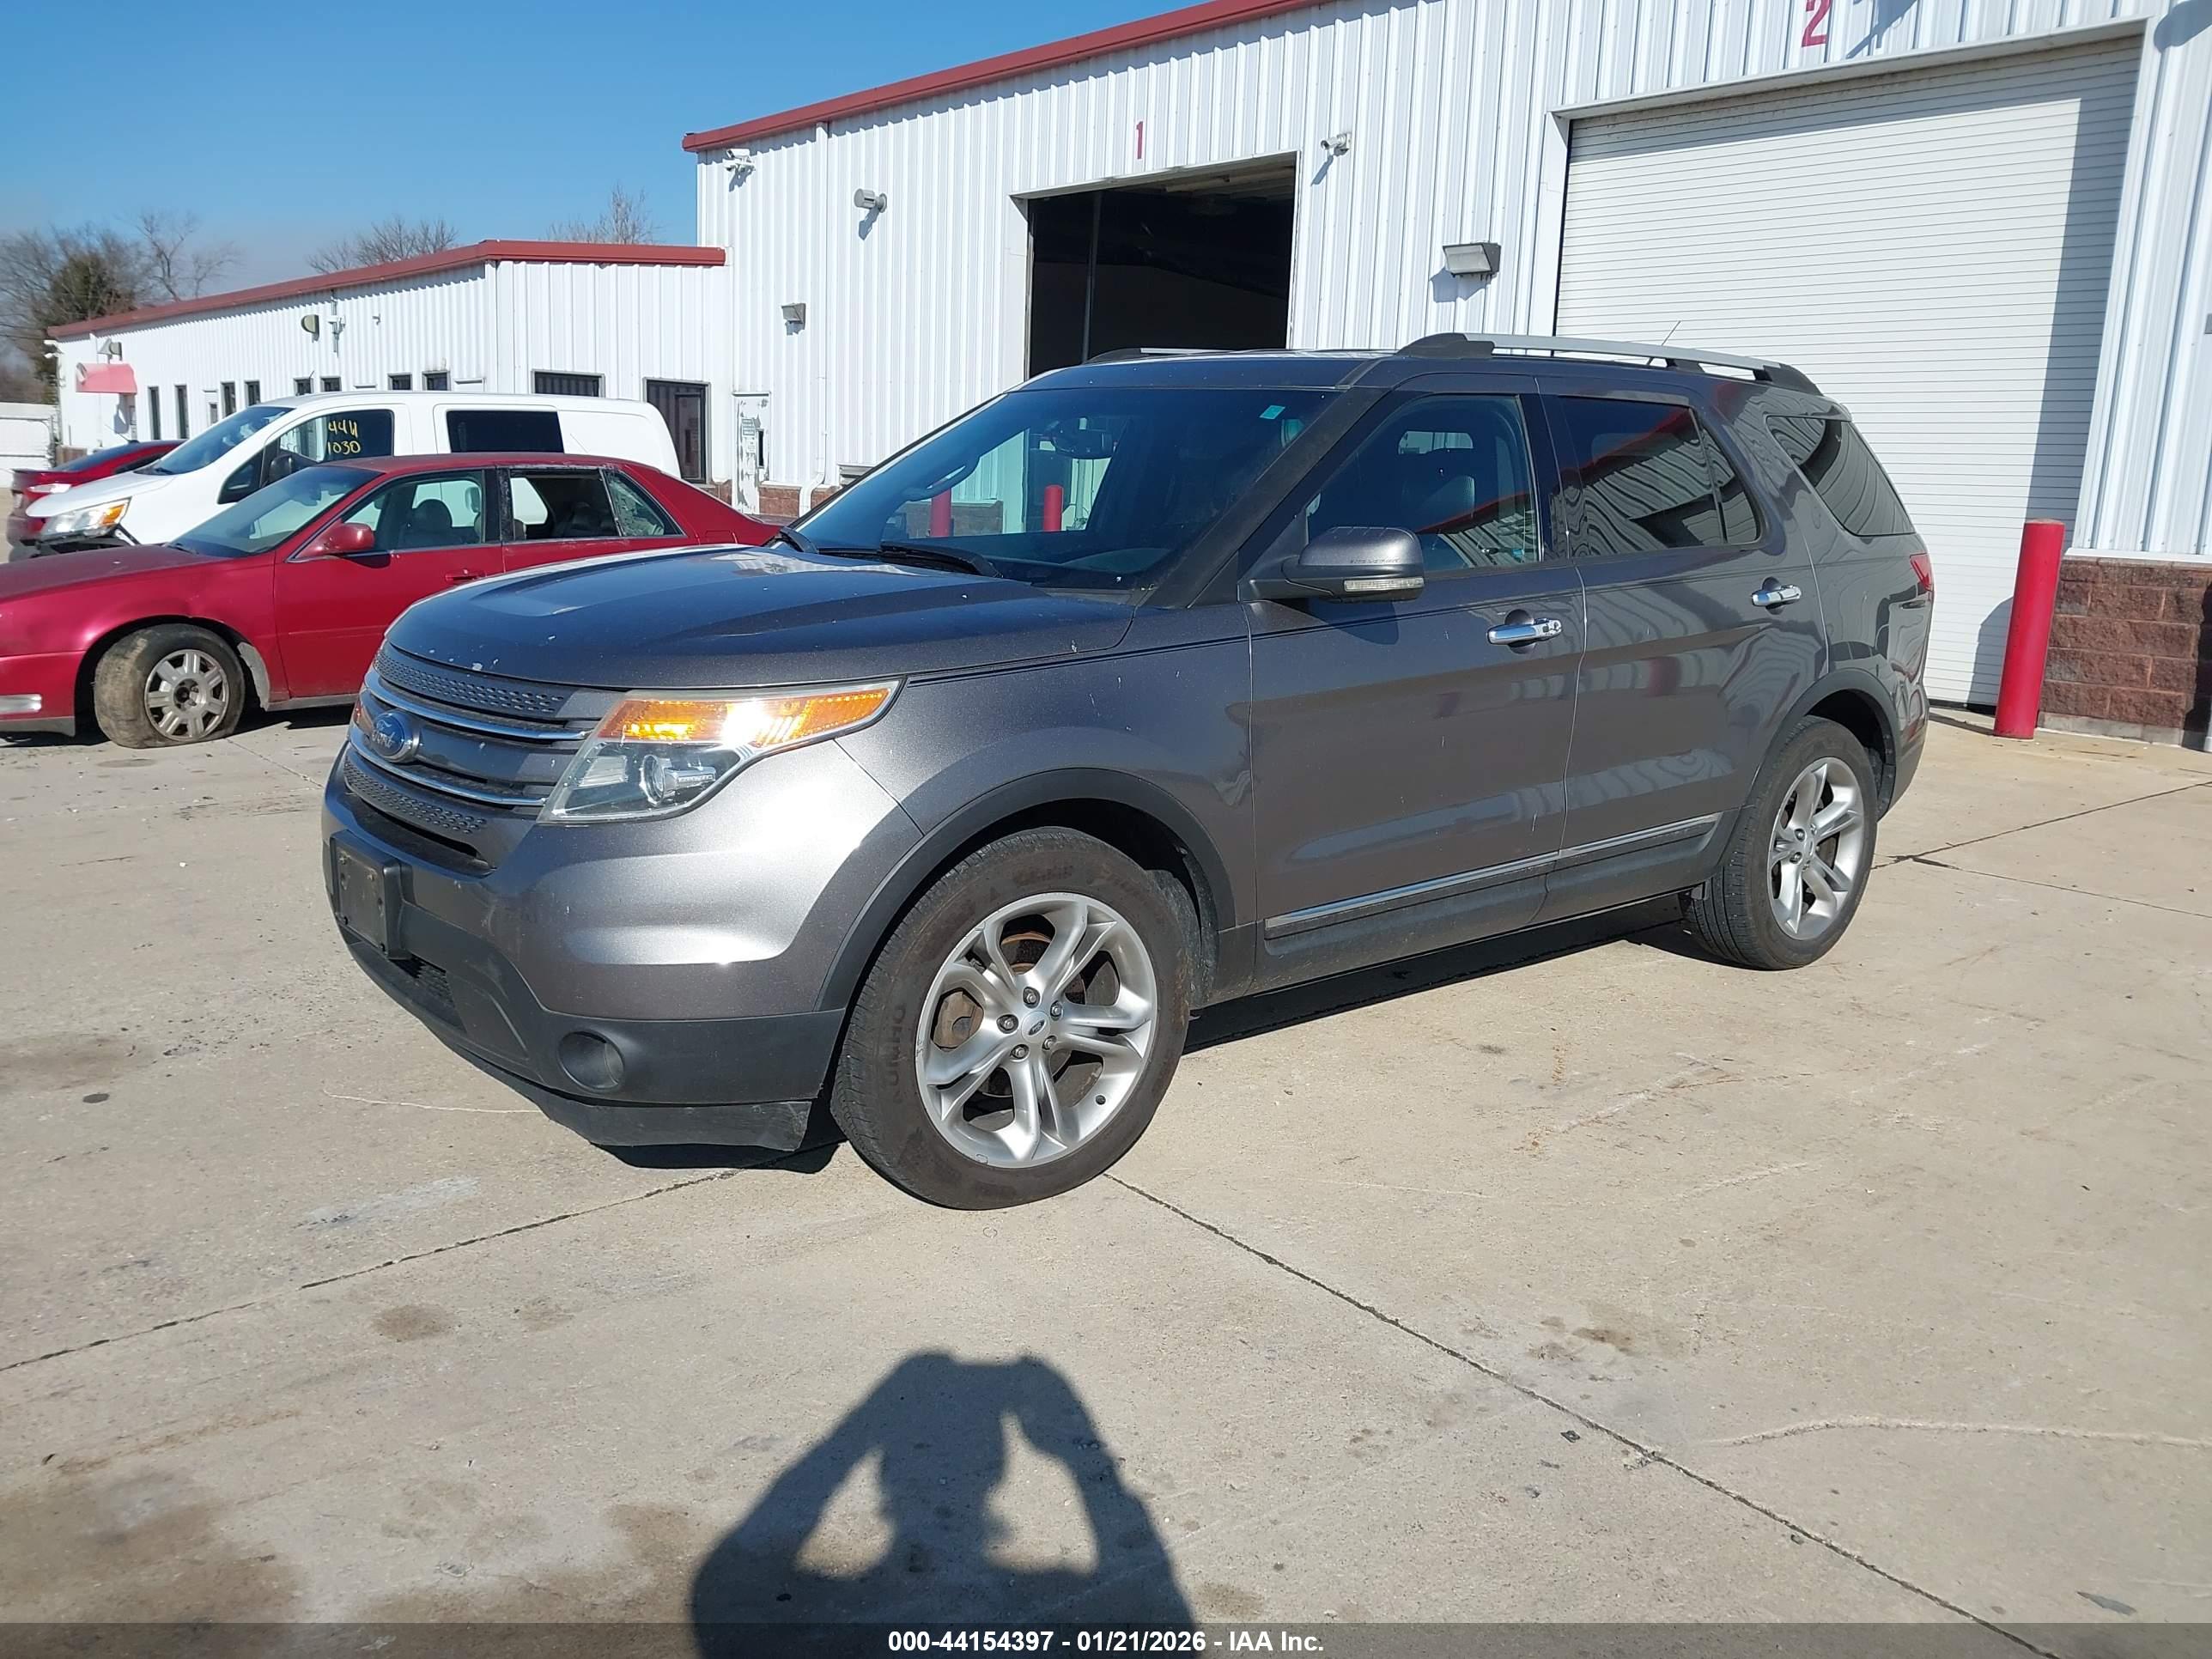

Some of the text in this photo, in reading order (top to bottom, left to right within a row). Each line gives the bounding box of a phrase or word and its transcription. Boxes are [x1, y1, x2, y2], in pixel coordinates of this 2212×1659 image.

[1802, 0, 1831, 47] 2
[1136, 121, 1143, 160] 1
[327, 441, 361, 455] 1030
